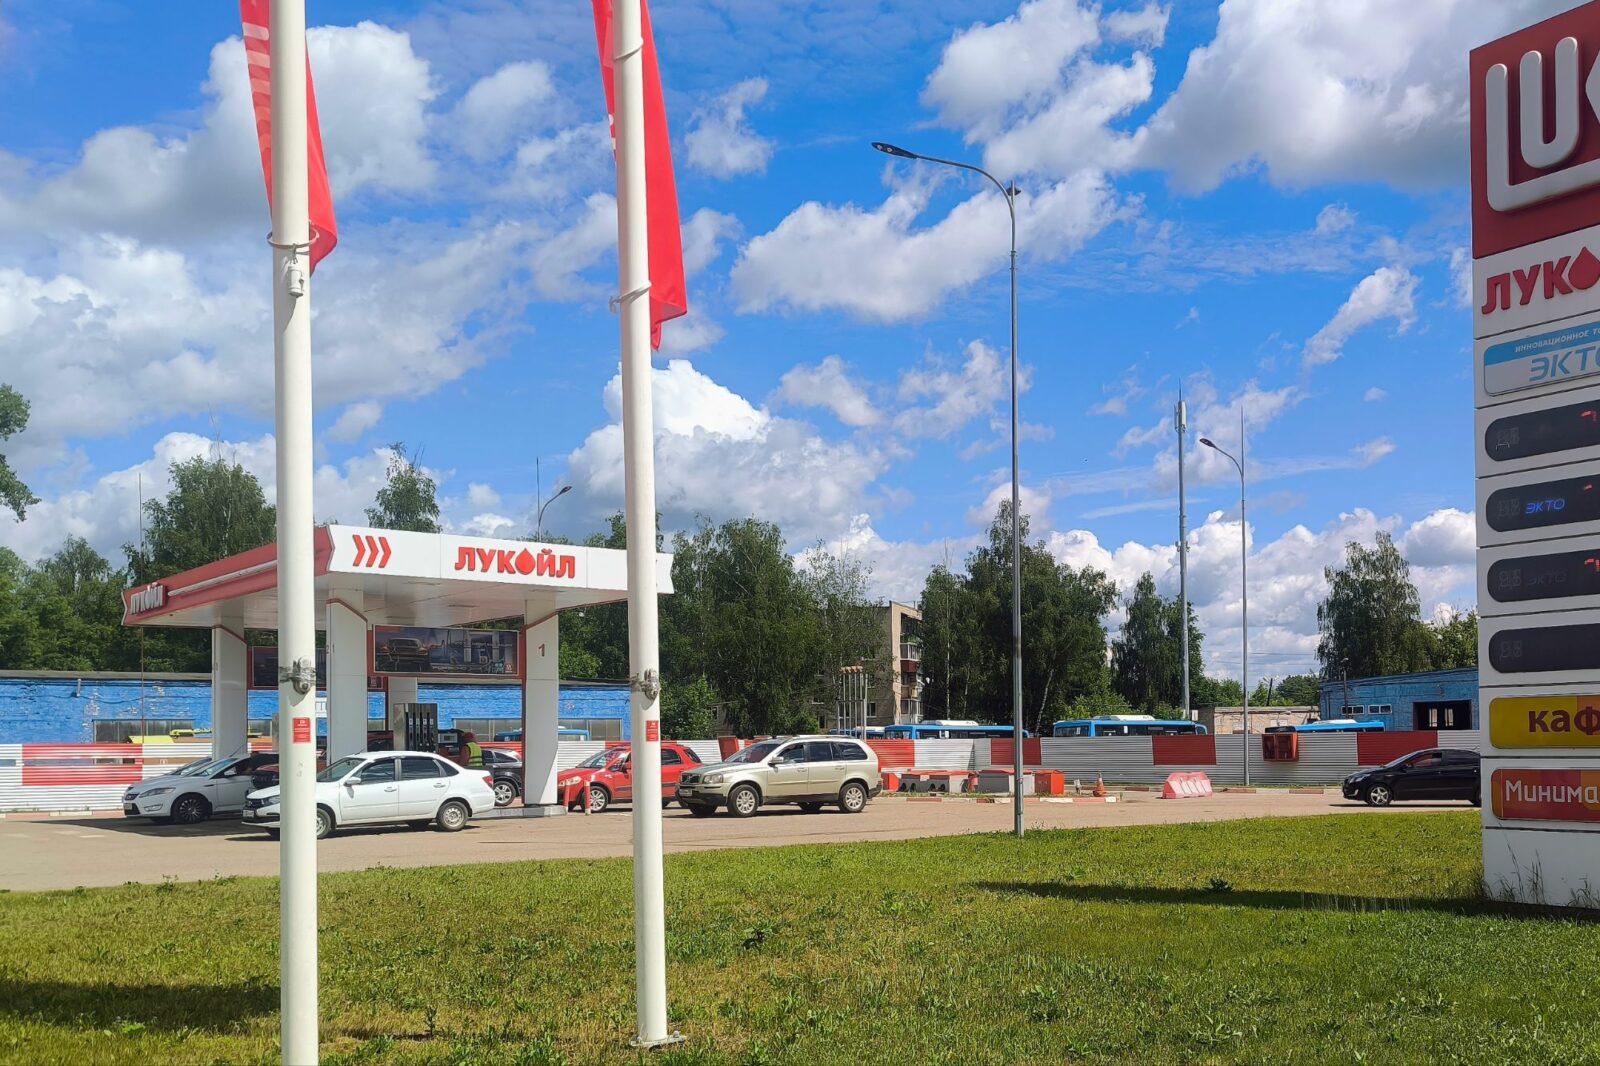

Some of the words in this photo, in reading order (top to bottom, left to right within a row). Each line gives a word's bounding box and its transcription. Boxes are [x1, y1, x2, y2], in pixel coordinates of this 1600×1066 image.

[1515, 330, 1589, 353] ИННОВАЦИОННОЕ
[1525, 499, 1566, 515] ЭКТО
[454, 547, 576, 579] ЛУКОЙЛ
[538, 643, 546, 657] 1
[1505, 779, 1600, 804] Минима
